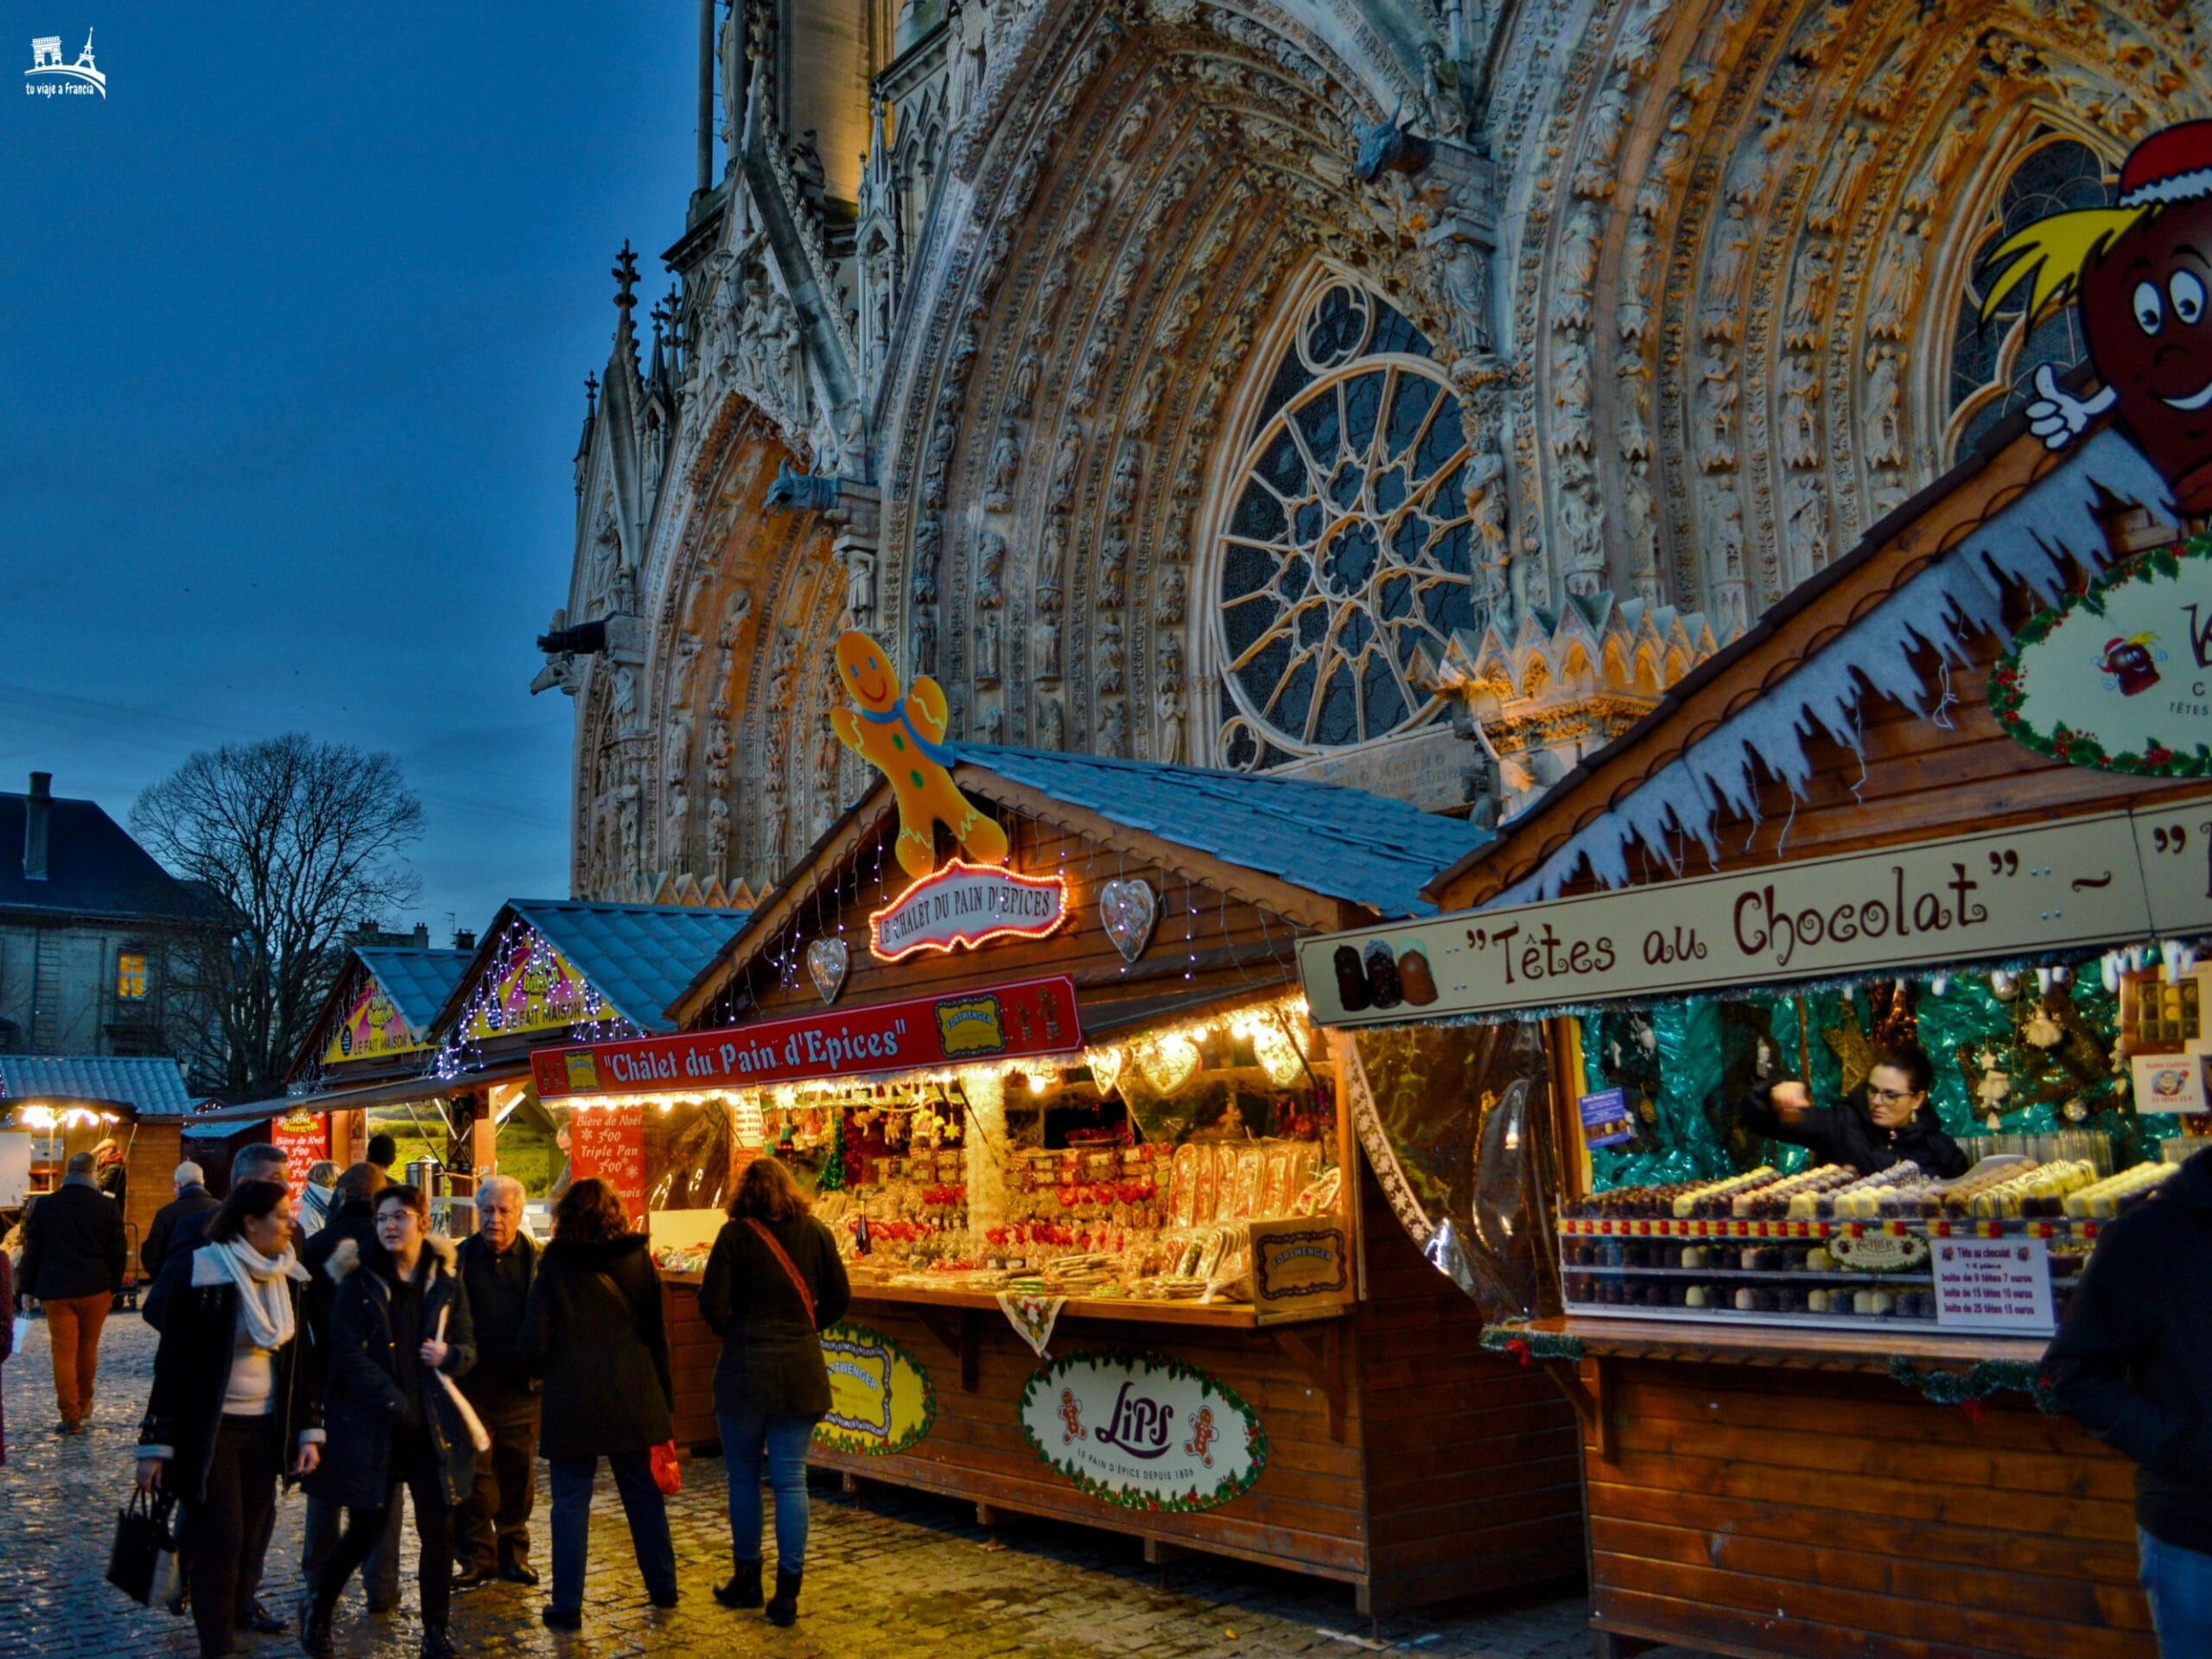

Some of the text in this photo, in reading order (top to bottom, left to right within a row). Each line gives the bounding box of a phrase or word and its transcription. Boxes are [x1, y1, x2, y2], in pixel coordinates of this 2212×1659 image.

[879, 886, 1051, 944] LE CHALET DU PAIN D'EPICES
[1643, 925, 1707, 965] au
[505, 1001, 582, 1029] LE FAIT MAISON
[686, 1046, 715, 1077] du
[719, 1039, 777, 1075] Pain
[576, 1115, 602, 1126] Bière
[606, 1115, 616, 1126] de
[581, 1145, 638, 1160] Triple Pan
[1963, 1274, 1972, 1282] de
[1962, 1288, 1970, 1297] de
[1963, 1303, 1972, 1313] de
[1078, 1448, 1086, 1459] LE
[1089, 1455, 1107, 1470] PAIN
[1144, 1470, 1172, 1480] DEPUIS
